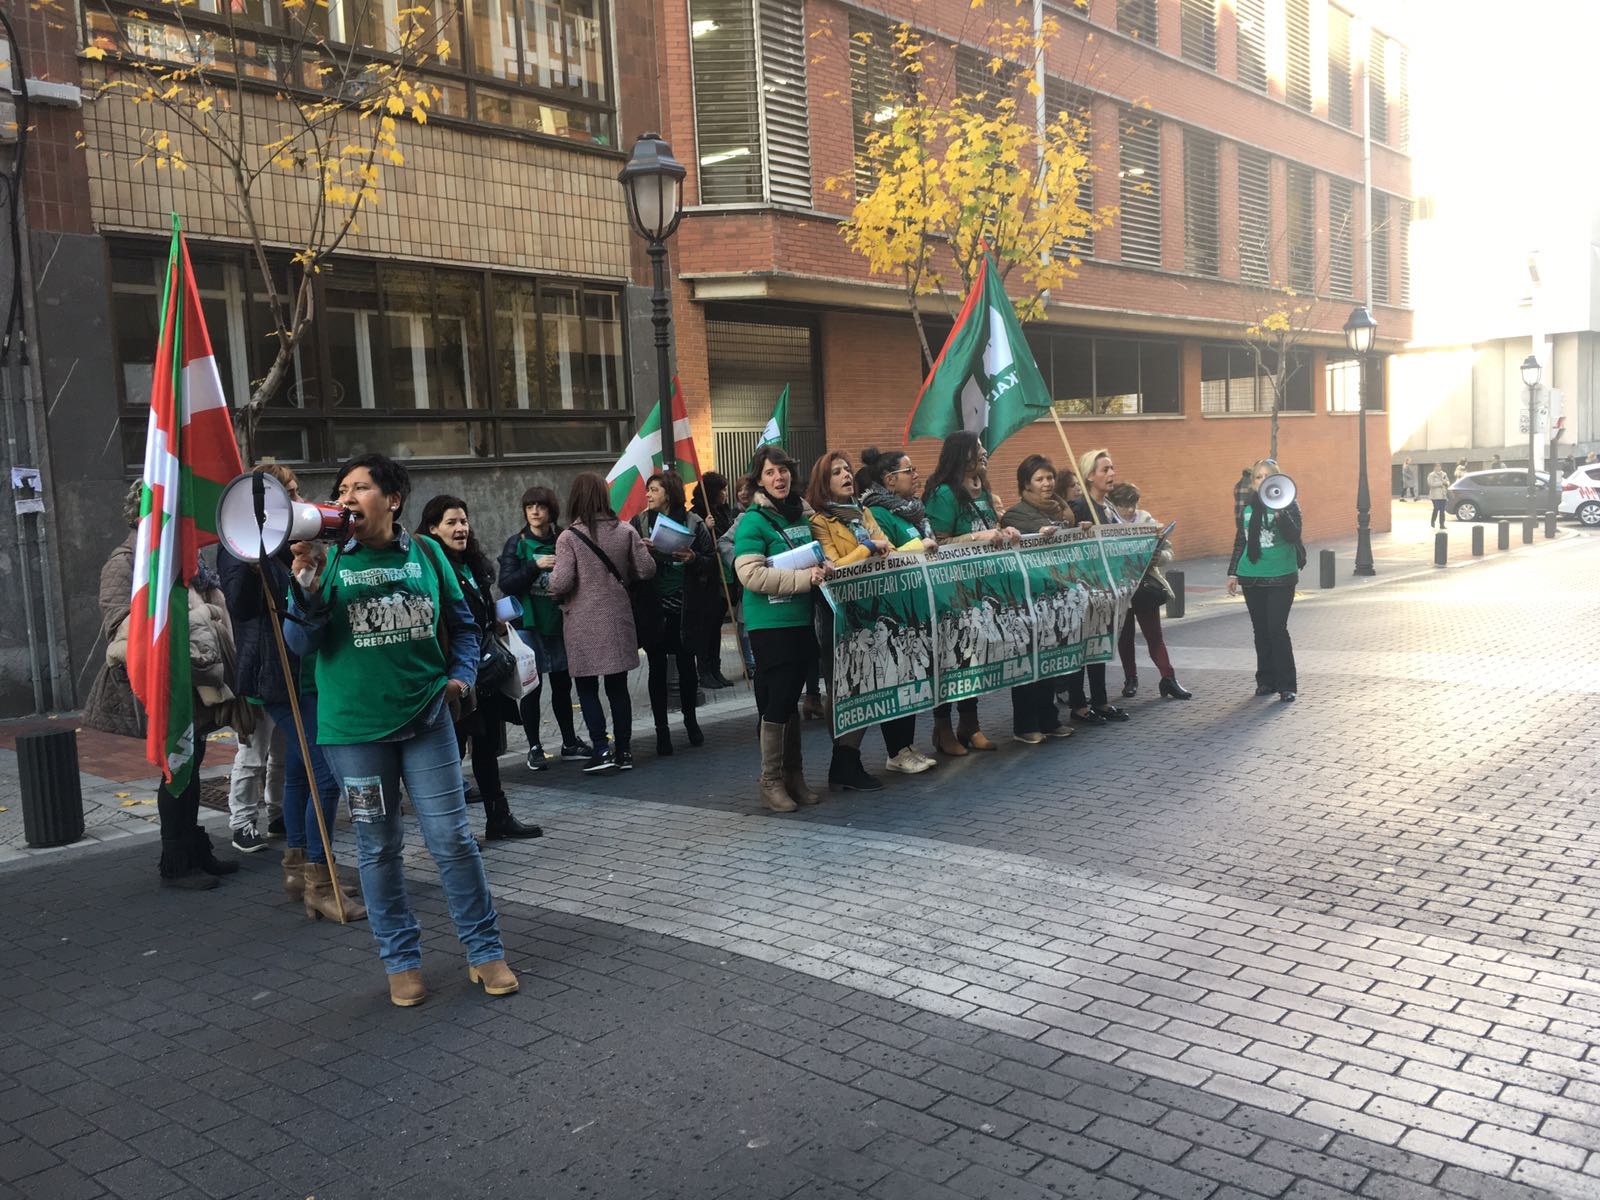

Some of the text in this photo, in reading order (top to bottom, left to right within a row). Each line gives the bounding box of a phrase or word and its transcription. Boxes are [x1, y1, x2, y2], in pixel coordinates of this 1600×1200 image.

[925, 547, 971, 562] RESIDENCIAS
[971, 545, 982, 555] DE
[1020, 534, 1061, 549] RESIDENCIAS
[1063, 533, 1072, 542] DE
[824, 555, 920, 581] SIDENCIAS DE BIZKAIA
[929, 556, 1017, 586] PREKARIETATEARI STOP
[830, 570, 923, 604] EKARIETATEARI STOP
[353, 632, 410, 648] GREBAN!!
[1085, 636, 1112, 656] ELA
[1003, 656, 1033, 679] ELA
[897, 680, 933, 706] ELA
[940, 671, 1001, 698] GREBAN!!
[837, 697, 896, 729] GREBAN!!
